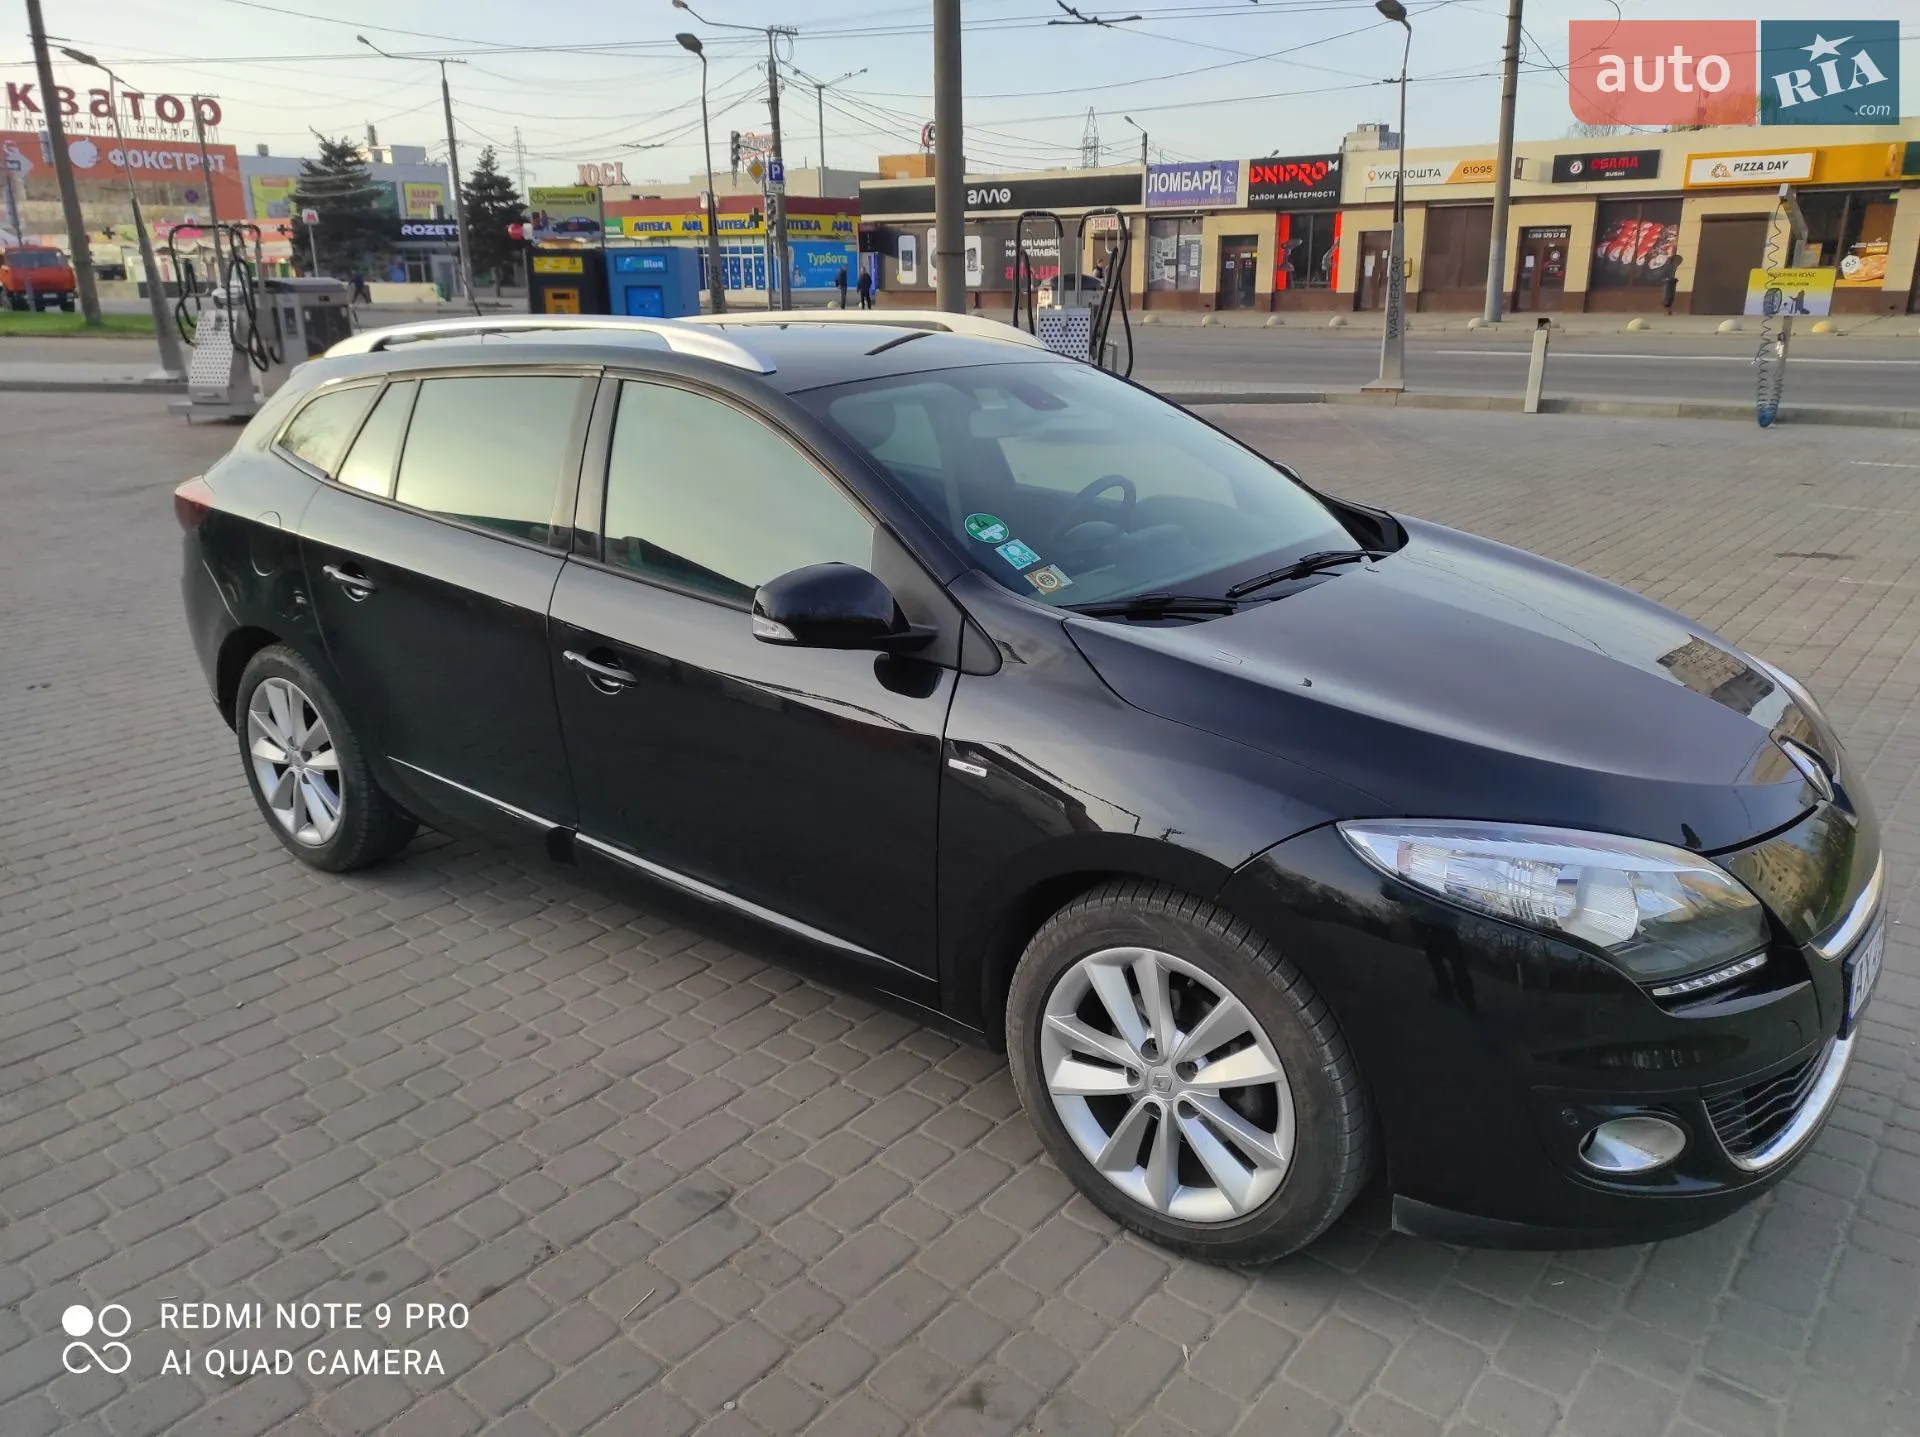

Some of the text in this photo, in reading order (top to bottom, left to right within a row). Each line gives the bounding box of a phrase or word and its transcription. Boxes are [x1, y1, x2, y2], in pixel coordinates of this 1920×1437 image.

[771, 164, 781, 179] P
[1463, 165, 1492, 175] 61095
[1733, 160, 1789, 172] PIZZA DAY
[1250, 160, 1328, 186] DNIPRO
[1148, 169, 1222, 194] ЛОМБАРД
[1277, 191, 1336, 200] МАЙСТЕРНОСТІ
[634, 221, 672, 232] АПТЕКА
[785, 219, 822, 231] ПТЕКА
[808, 252, 848, 266] Турбота
[1388, 255, 1401, 340] WASHERCAR
